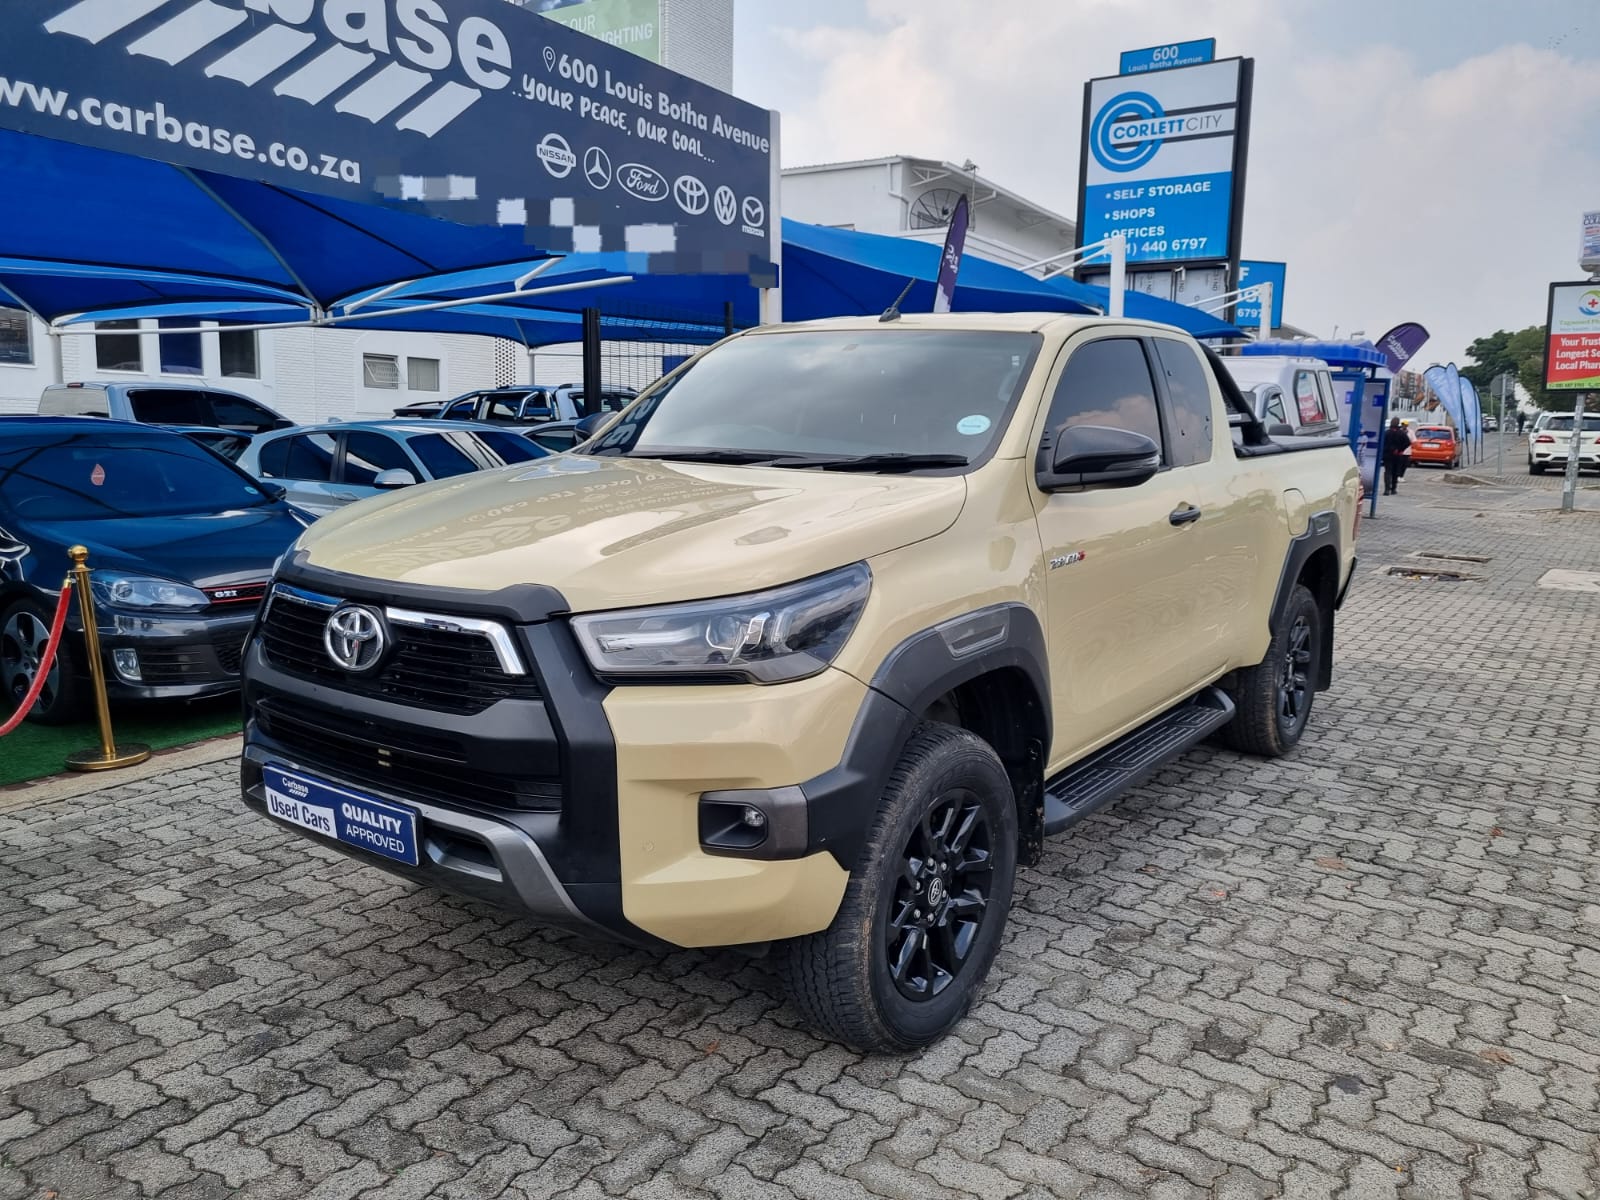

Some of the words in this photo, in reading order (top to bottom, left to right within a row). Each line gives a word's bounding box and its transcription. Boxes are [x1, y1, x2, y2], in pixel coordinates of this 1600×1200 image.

[592, 23, 653, 46] IGHTING
[1153, 46, 1179, 61] 600
[559, 54, 599, 88] 600
[605, 70, 653, 111] Louis
[658, 92, 707, 131] Botha
[712, 115, 769, 154] Avenue
[637, 117, 667, 144] OUR
[538, 148, 576, 165] NISSAN
[626, 168, 659, 195] Ford
[1113, 187, 1144, 200] SELF
[1148, 181, 1211, 197] STORAGE
[1112, 207, 1155, 220] SHOPS
[1111, 225, 1165, 239] OFFICES
[1141, 240, 1167, 252] 440
[1172, 237, 1207, 251] 6797
[1560, 337, 1579, 346] Your
[1556, 348, 1589, 359] Longest
[1555, 361, 1577, 370] Local
[1579, 360, 1600, 370] Phar
[214, 590, 238, 598] GTI
[282, 777, 309, 794] Carbase
[270, 794, 299, 820] Used
[302, 805, 331, 832] Cars
[341, 802, 402, 834] QUALITY
[346, 823, 405, 853] APPROVED
